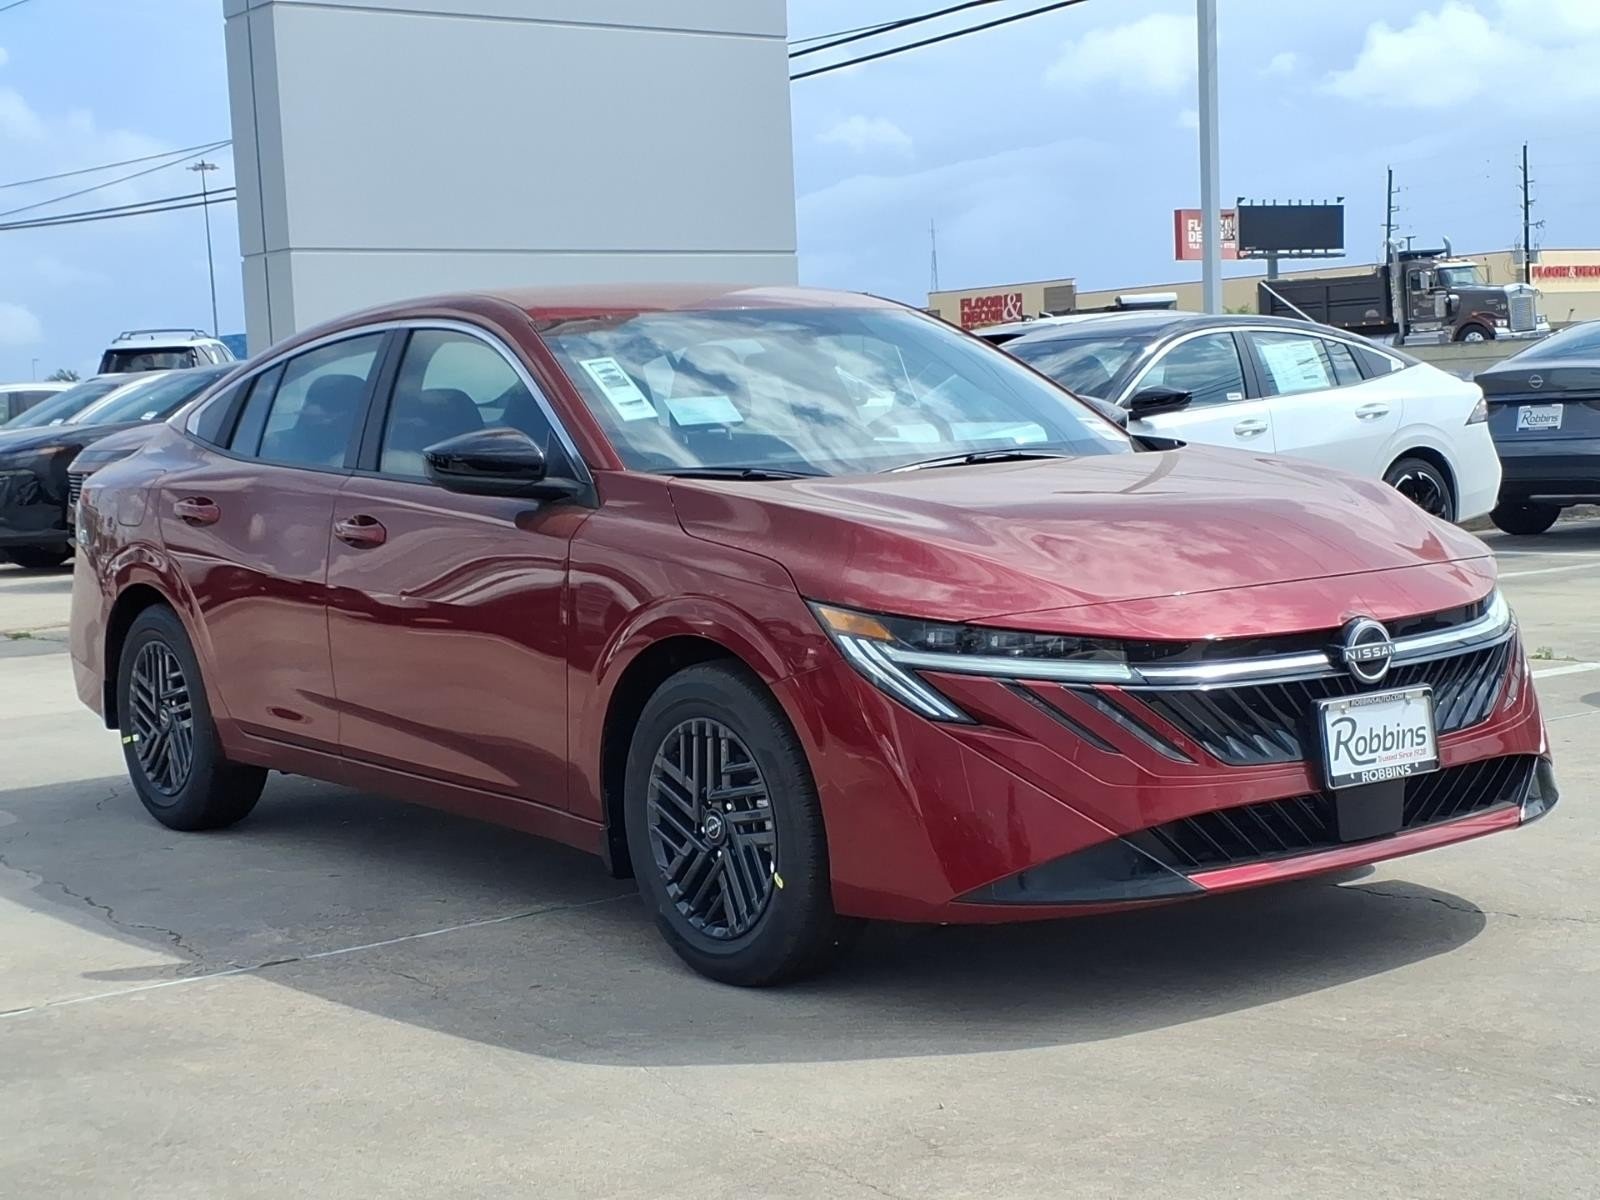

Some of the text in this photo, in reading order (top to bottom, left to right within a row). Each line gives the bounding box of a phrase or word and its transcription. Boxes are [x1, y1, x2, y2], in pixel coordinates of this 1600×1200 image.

[960, 295, 1003, 310] FLOOR
[961, 309, 1003, 323] DECOR
[1521, 409, 1559, 426] Robbins
[1345, 646, 1396, 660] NISSAN
[1331, 717, 1426, 766] Robbins
[1362, 764, 1411, 782] ROBBINS
